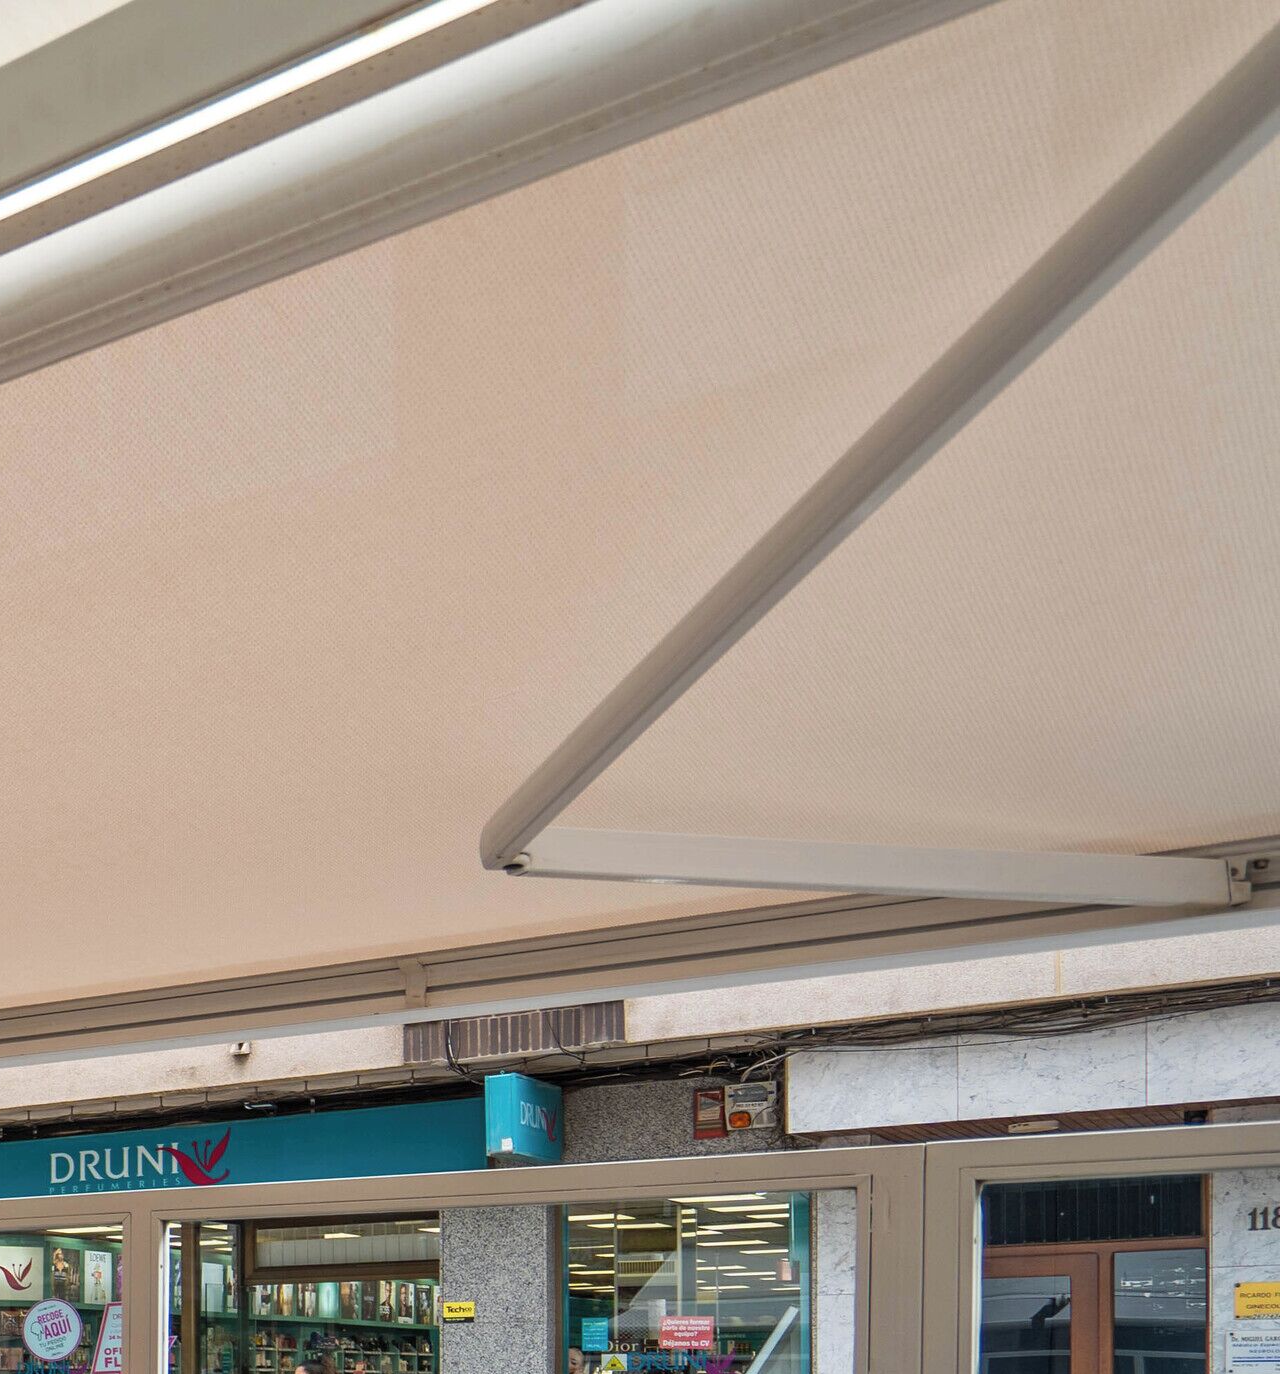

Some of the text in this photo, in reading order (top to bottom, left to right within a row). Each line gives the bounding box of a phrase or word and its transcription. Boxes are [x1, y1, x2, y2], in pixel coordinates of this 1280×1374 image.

[50, 1142, 180, 1184] DRUNI
[37, 1309, 64, 1323] RECOGE
[44, 1314, 72, 1339] AQUÍ
